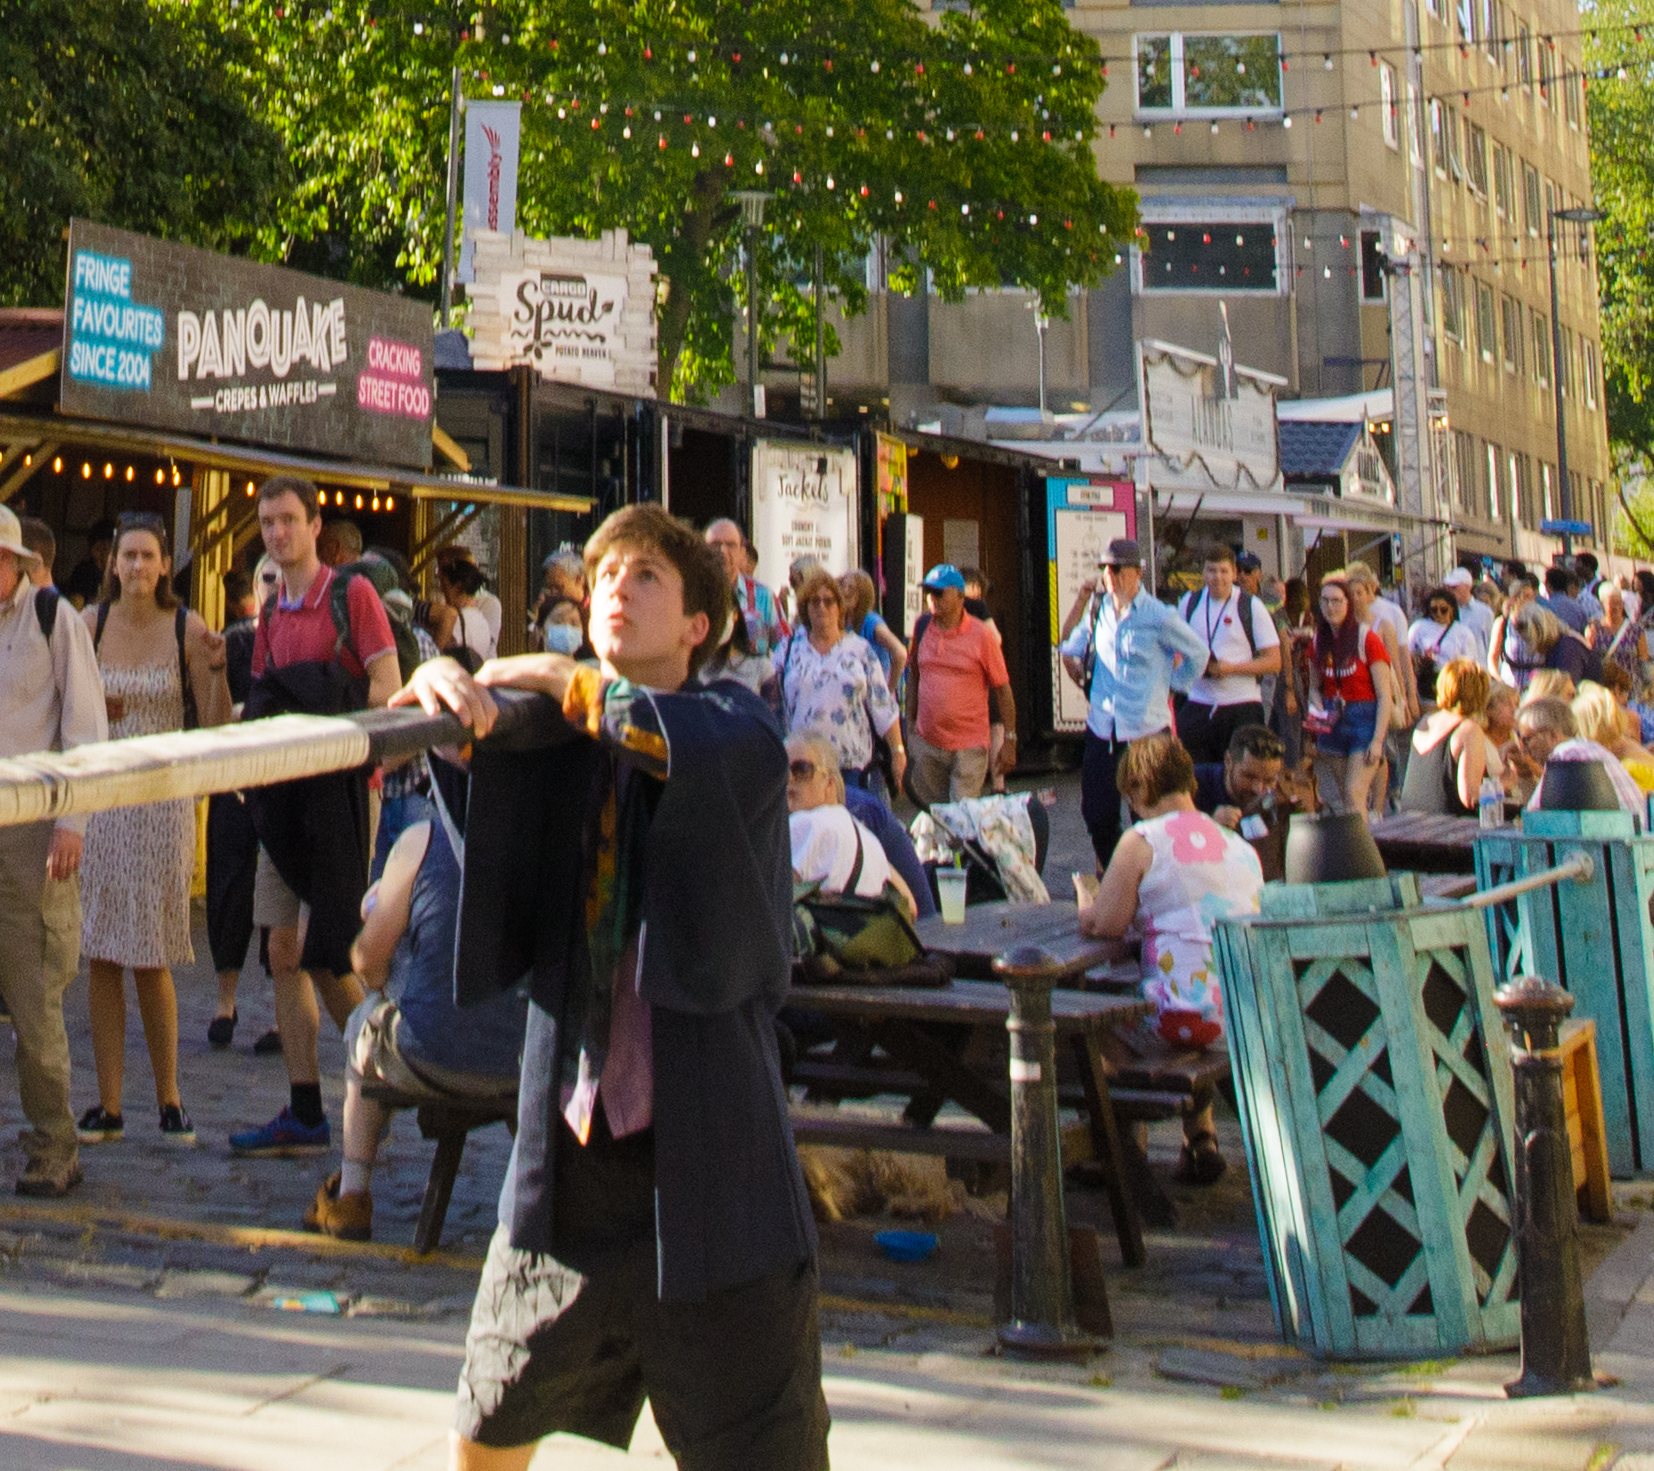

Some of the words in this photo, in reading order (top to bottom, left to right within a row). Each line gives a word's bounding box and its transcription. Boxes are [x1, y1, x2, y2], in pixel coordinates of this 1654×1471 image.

[75, 254, 131, 298] FRINGE
[73, 297, 164, 347] FAVOURITES
[514, 279, 607, 342] Spud
[177, 295, 348, 381] PANQUAKE
[368, 338, 421, 377] CRACKING
[71, 341, 117, 379] SINCE
[117, 350, 151, 386] 2004
[215, 385, 257, 413] CREPES
[258, 384, 267, 408] &
[269, 380, 318, 408] WAFFLES
[358, 377, 397, 410] STREET
[398, 385, 430, 417] FOOD
[778, 469, 829, 502] Jackets
